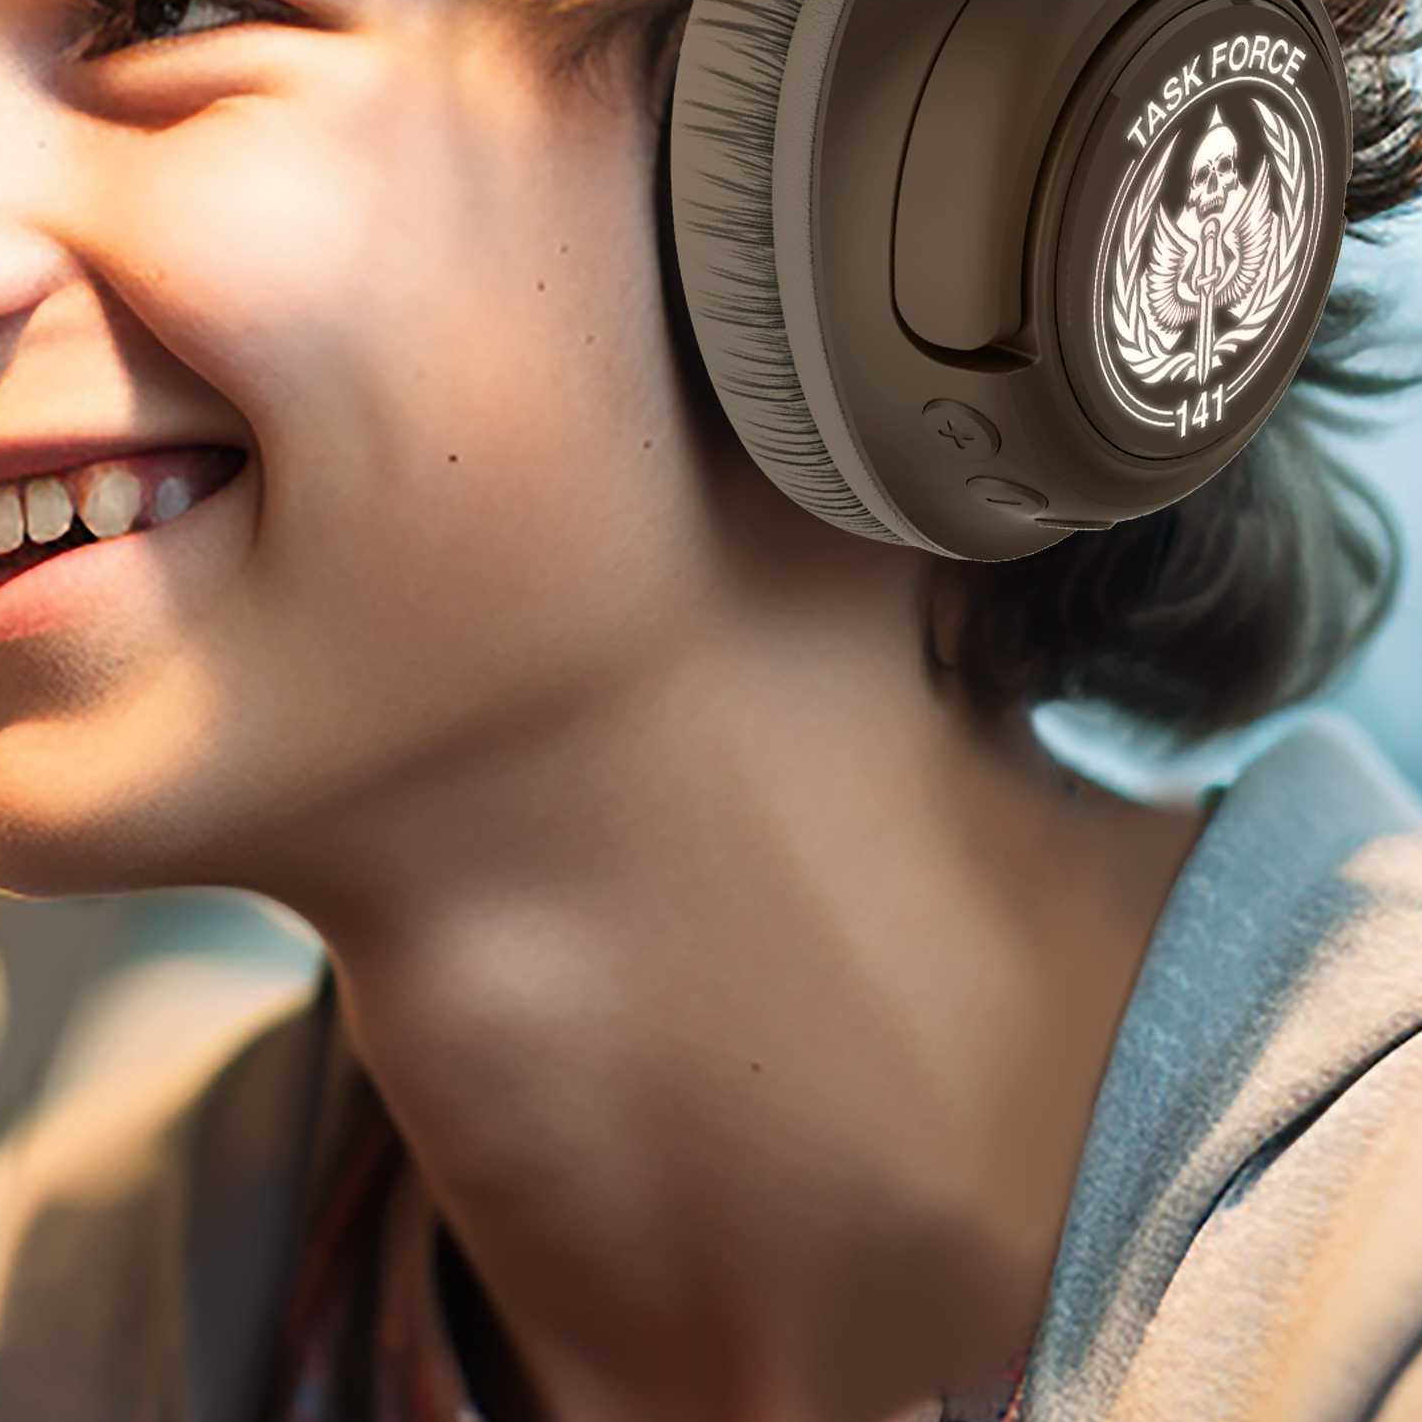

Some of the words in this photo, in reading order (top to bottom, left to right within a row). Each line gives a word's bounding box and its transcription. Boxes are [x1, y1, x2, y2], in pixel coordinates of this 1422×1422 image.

[1126, 54, 1203, 149] TASK
[1211, 35, 1306, 85] FORCE
[1176, 383, 1224, 438] 141
